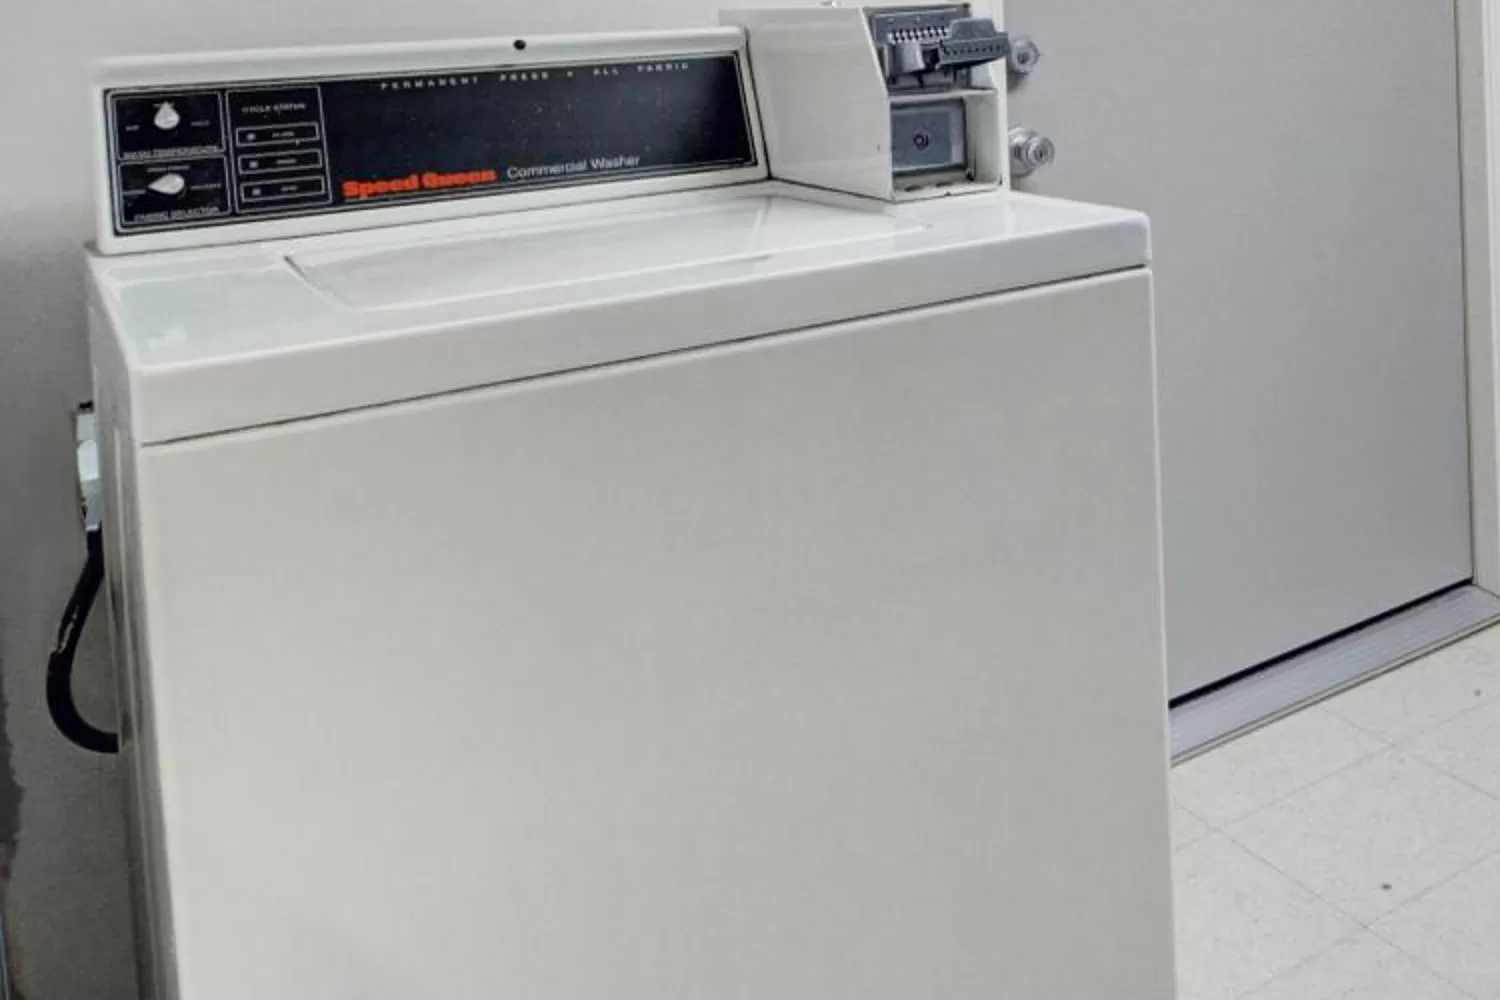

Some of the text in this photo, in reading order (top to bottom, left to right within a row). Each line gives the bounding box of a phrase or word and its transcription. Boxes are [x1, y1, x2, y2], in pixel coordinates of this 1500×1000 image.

[507, 154, 641, 179] Commercial Washer
[342, 168, 497, 200] Speed Queen
